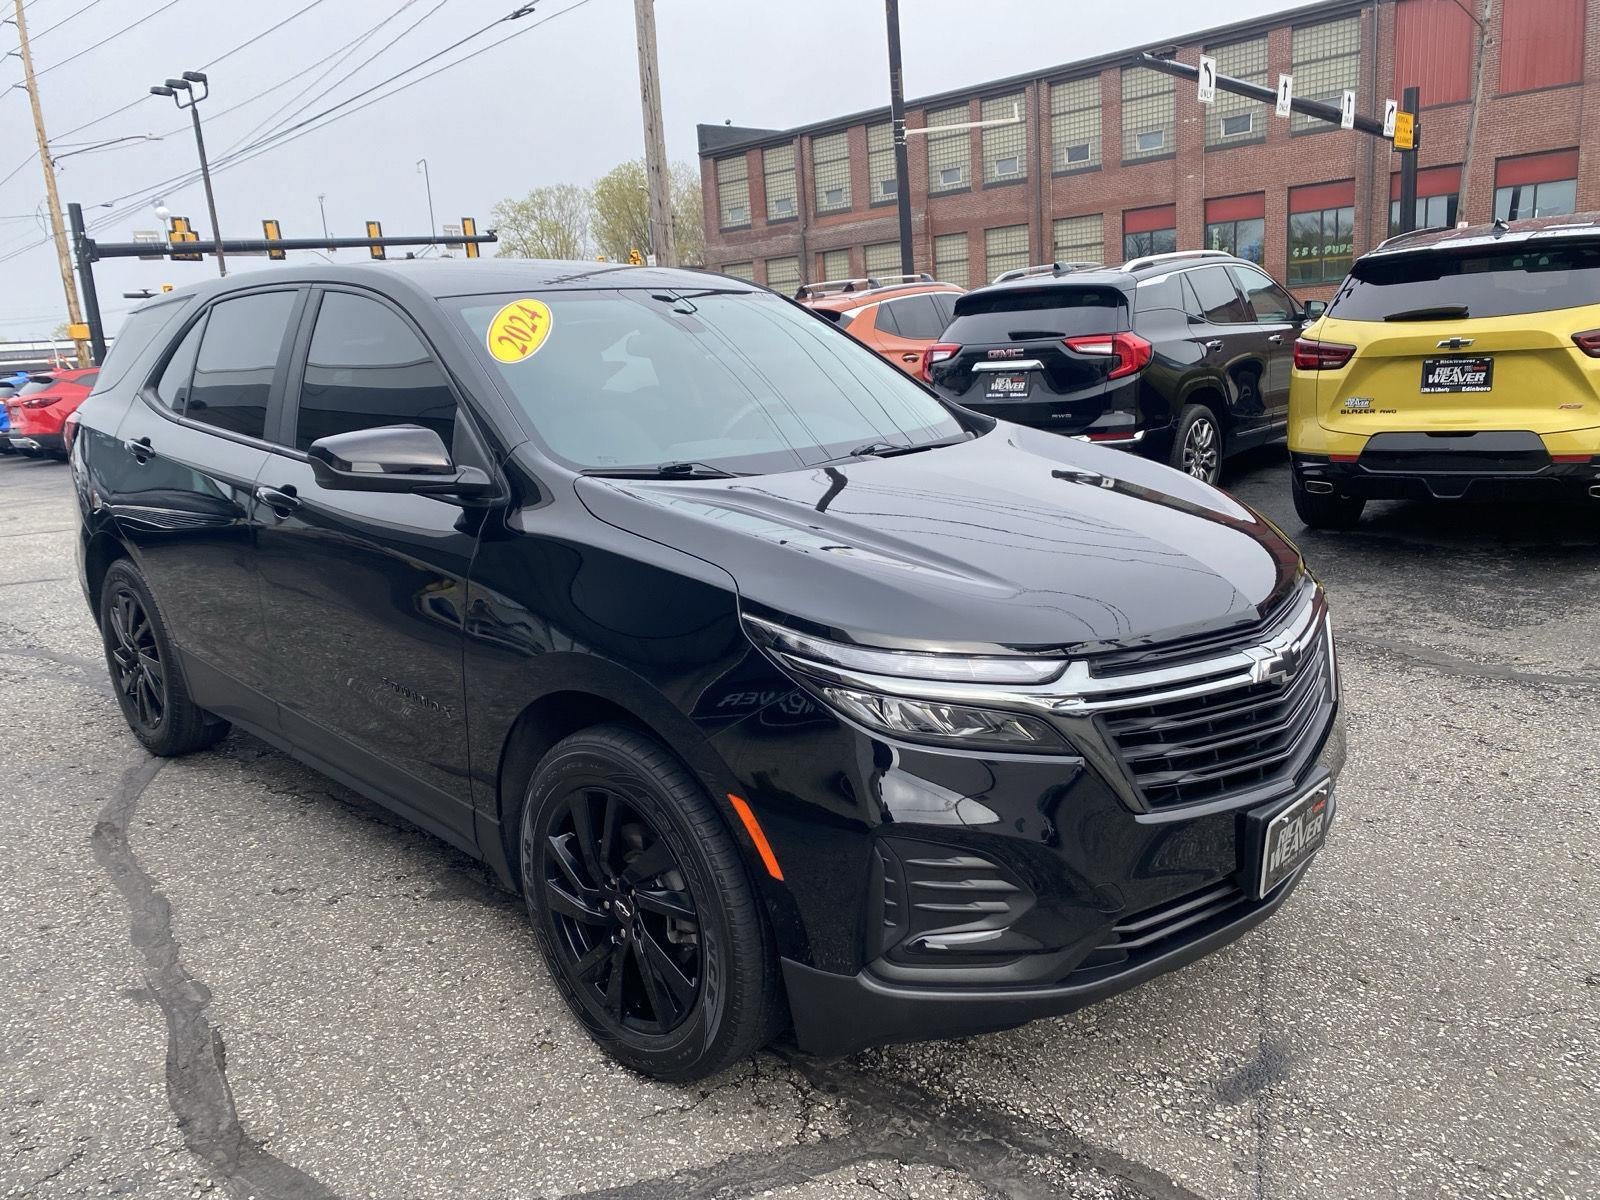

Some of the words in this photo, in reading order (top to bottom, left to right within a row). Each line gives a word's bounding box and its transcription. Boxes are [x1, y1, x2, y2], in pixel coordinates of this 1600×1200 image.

[498, 305, 543, 356] 2024
[988, 348, 1024, 359] GMC
[1434, 366, 1463, 375] RICK
[1428, 372, 1486, 383] WEAVER
[991, 382, 1026, 391] WEAVER
[1269, 813, 1324, 872] WEAVER
